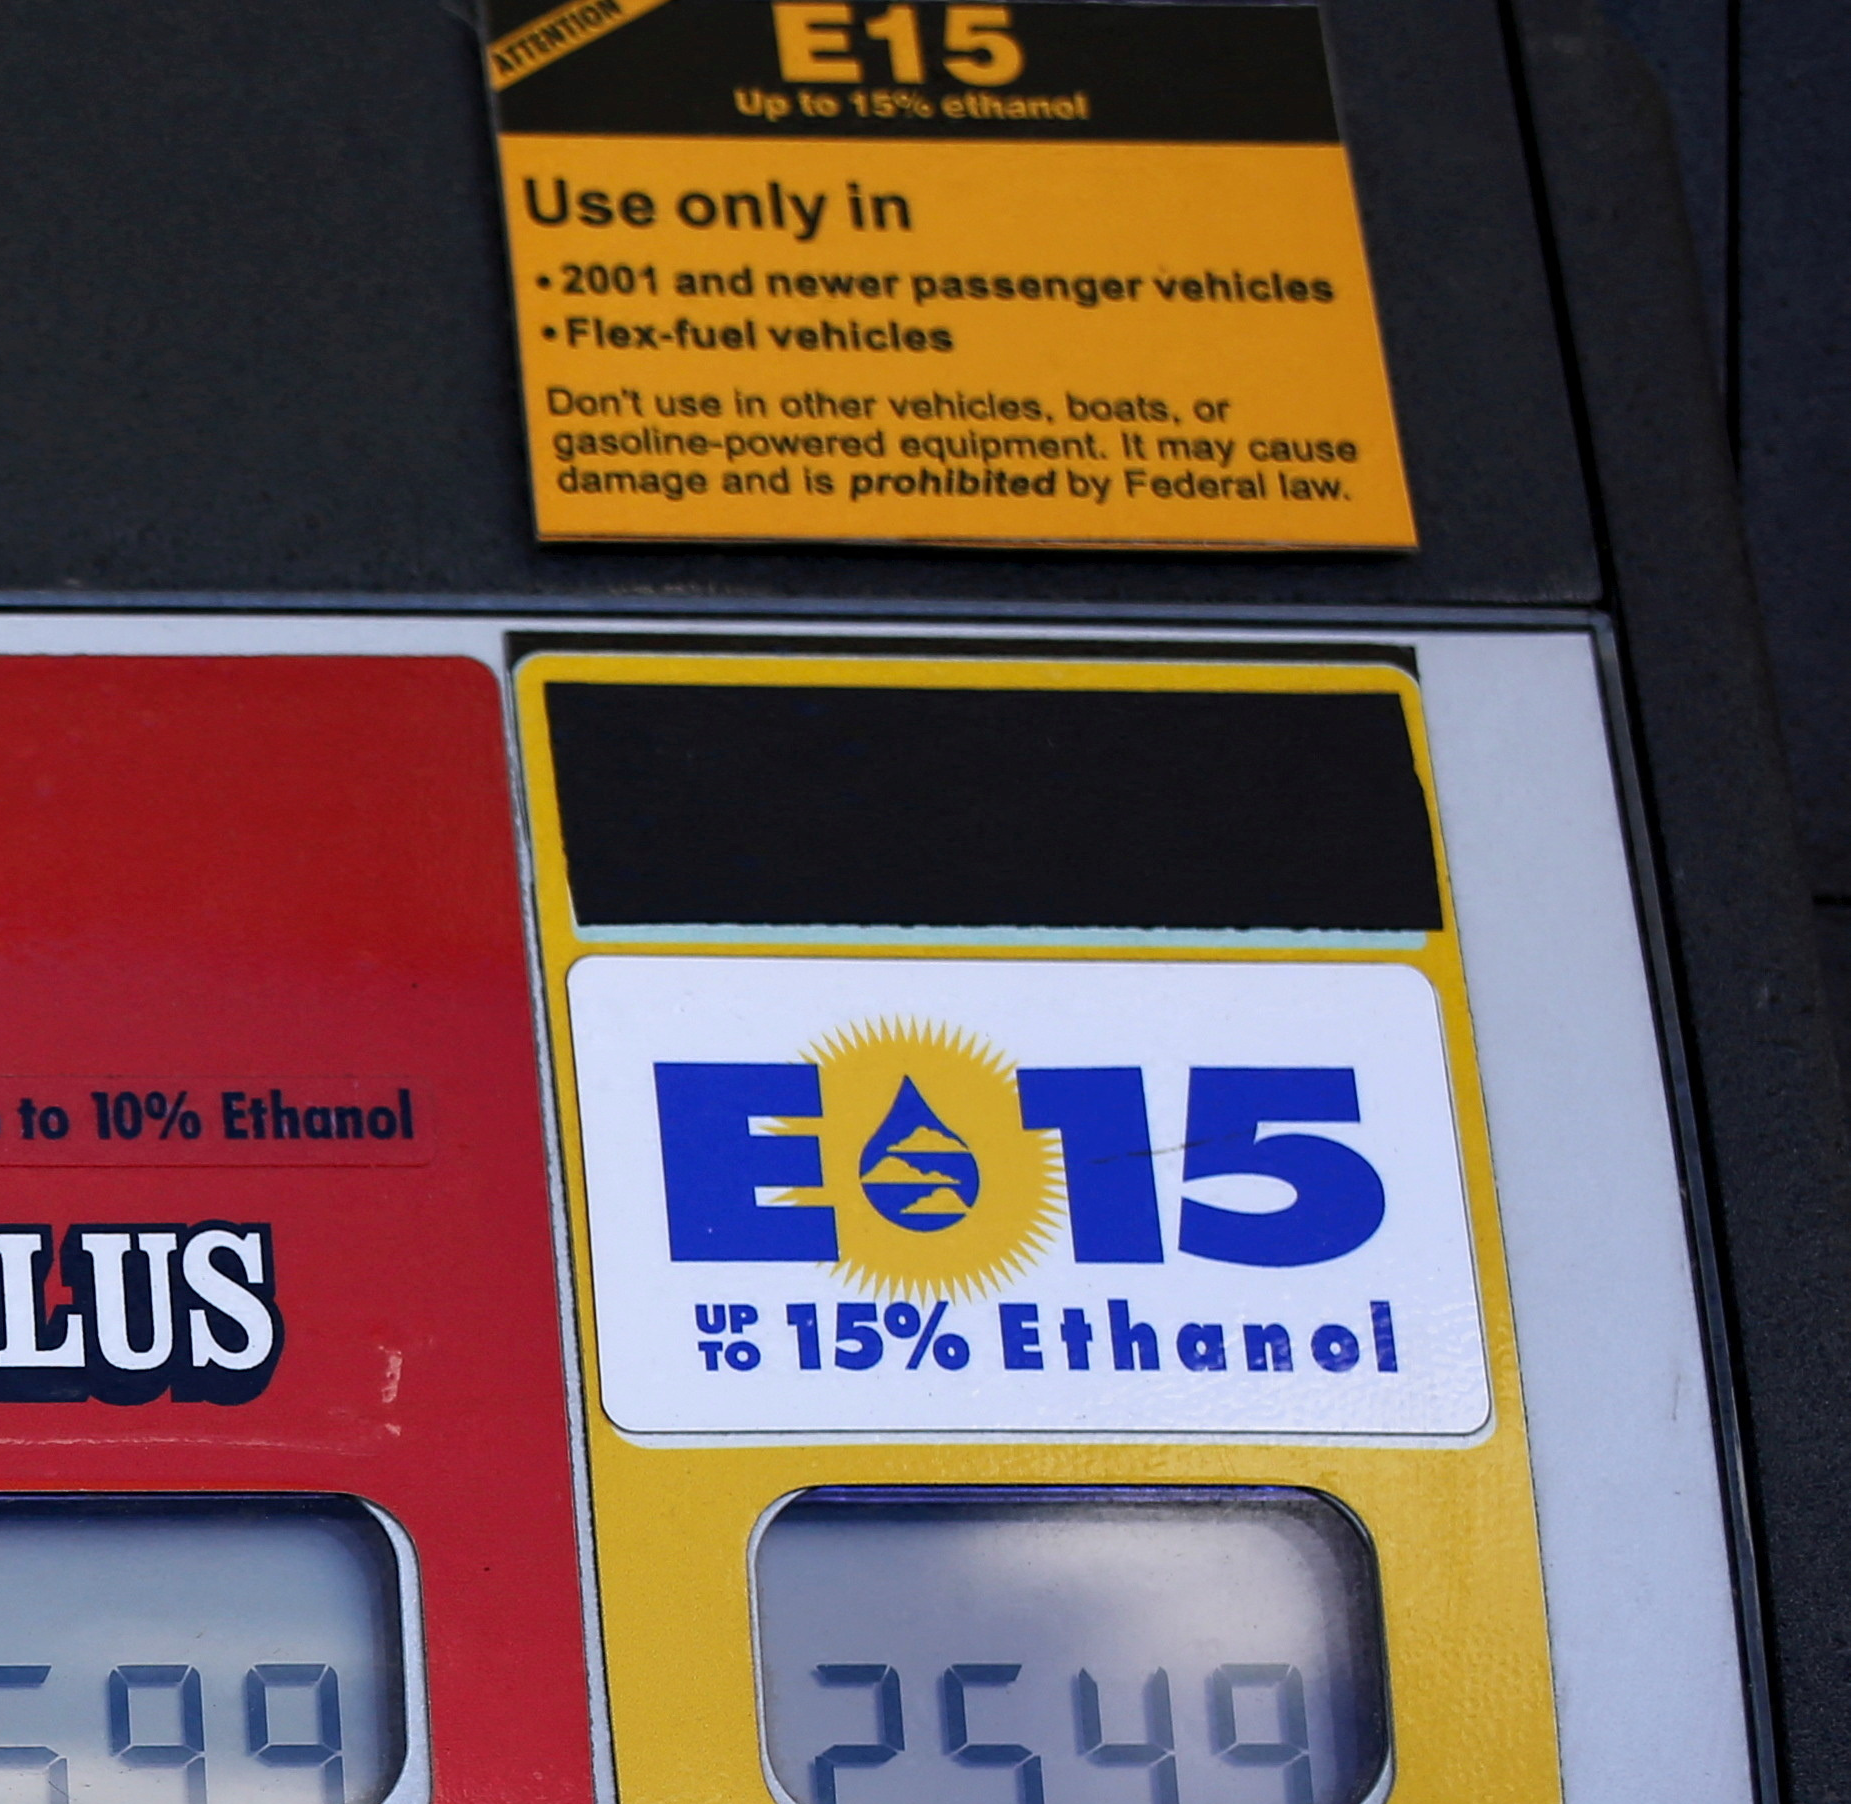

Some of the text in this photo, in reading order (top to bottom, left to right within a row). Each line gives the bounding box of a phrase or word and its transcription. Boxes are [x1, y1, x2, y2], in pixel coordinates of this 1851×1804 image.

[493, 0, 622, 76] ATTENTION
[772, 2, 1025, 87] E15
[735, 88, 1089, 121] Up to 15% ethanol
[523, 176, 912, 242] Use only in
[561, 264, 1334, 308] 2001 and newer passenger vehicles
[565, 317, 954, 352] Flex-fuel vehicles
[547, 387, 1230, 425] Don't use in other vehicles, boats, or
[553, 428, 1358, 467] gasoline-powered equipment. It may cause
[558, 466, 1350, 504] damage and is prohibited by Federal law.
[19, 1096, 69, 1140] to
[94, 1091, 201, 1140] 10%
[222, 1089, 415, 1141] Ethanol
[694, 1299, 1398, 1373] UP TO 15% Ethanol
